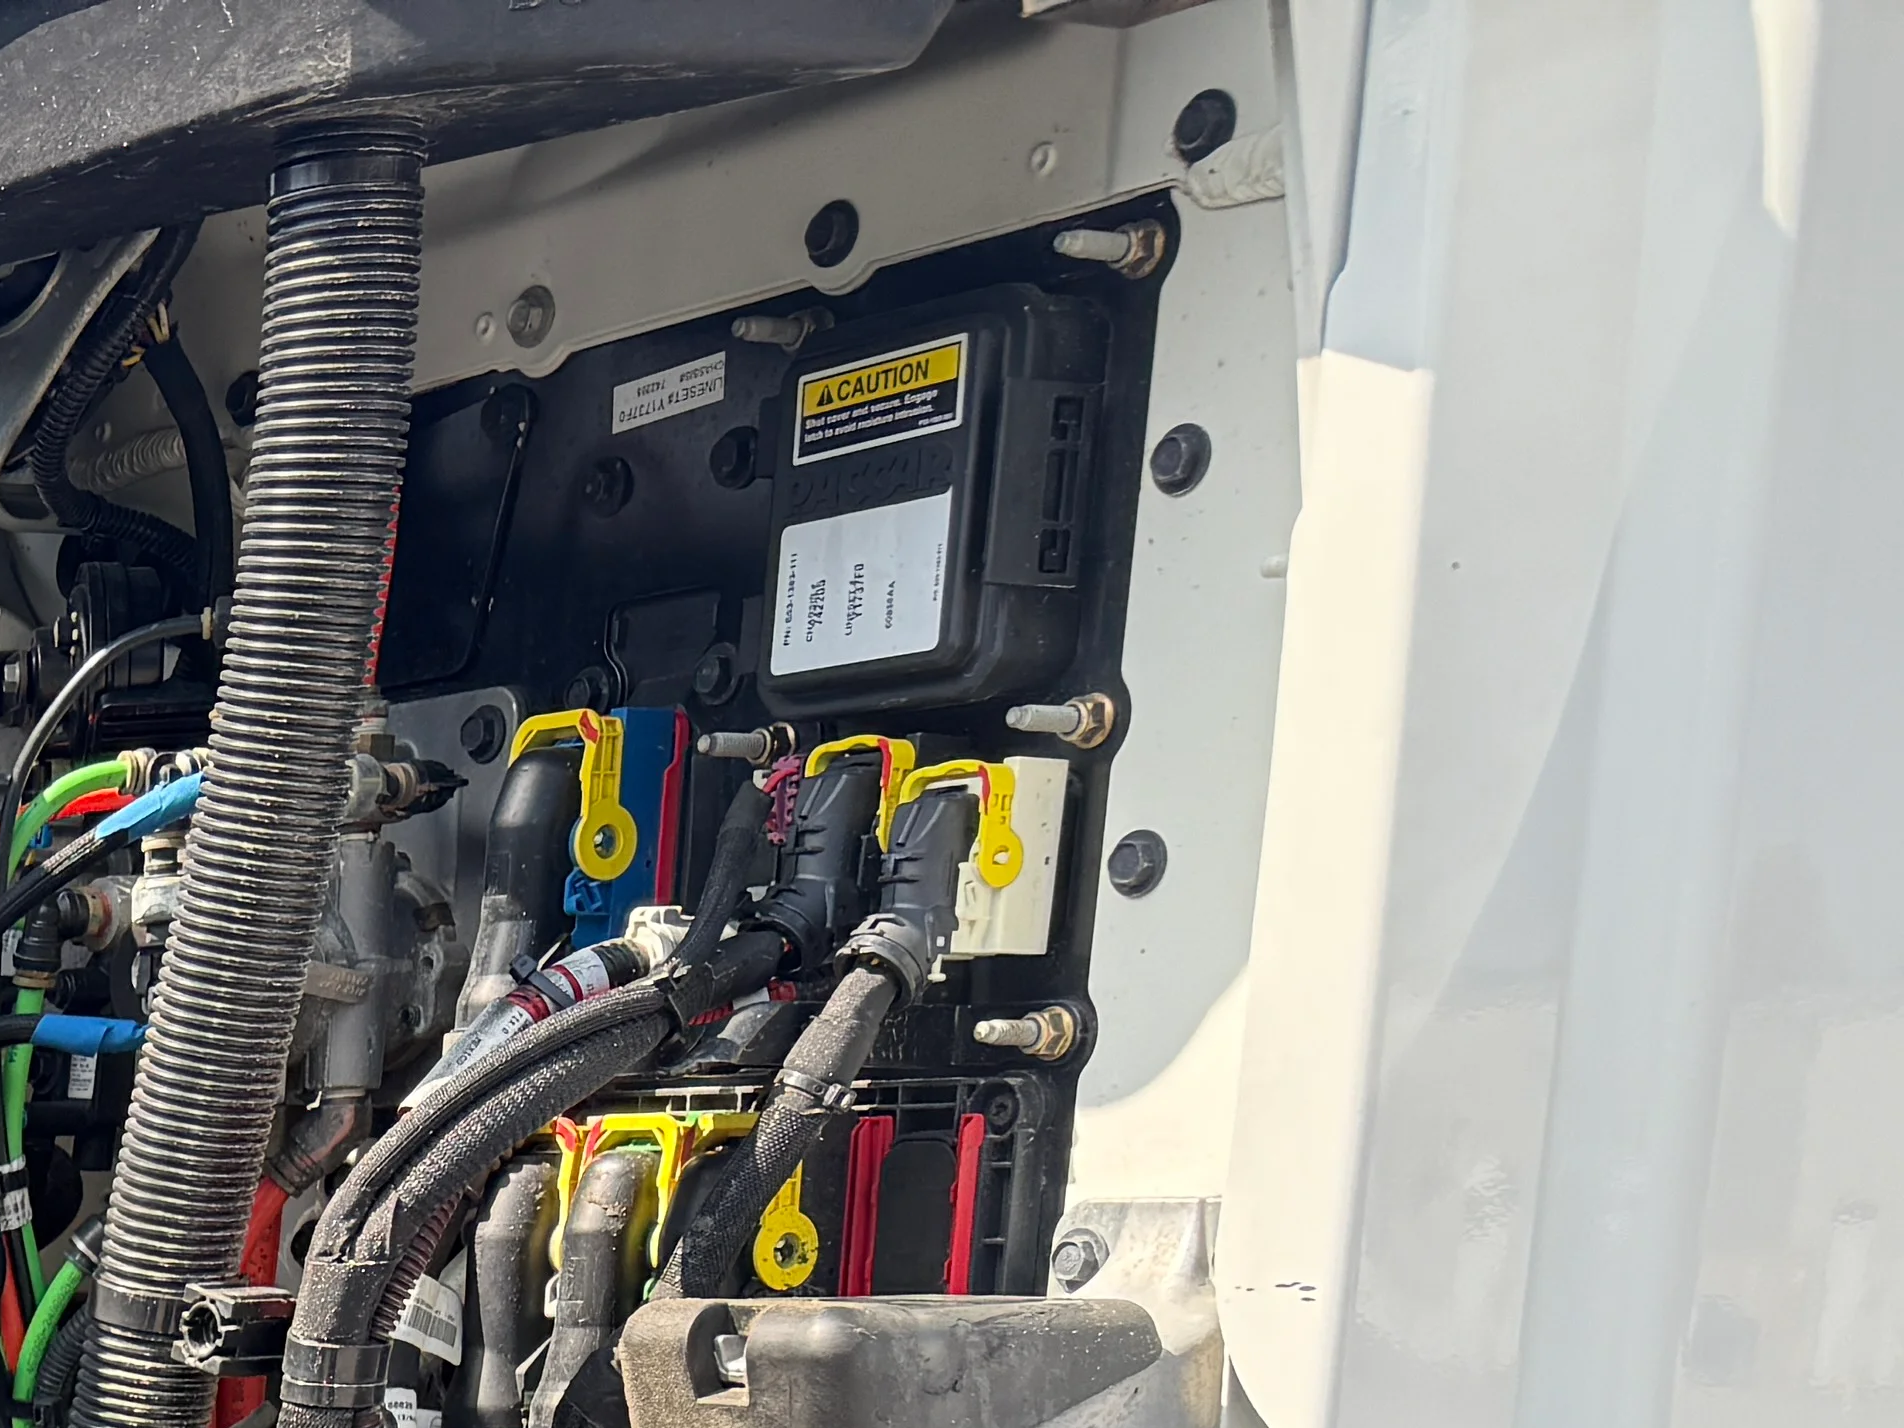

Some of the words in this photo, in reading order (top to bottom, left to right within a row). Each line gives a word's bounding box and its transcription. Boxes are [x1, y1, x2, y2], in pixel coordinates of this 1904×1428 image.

[836, 357, 929, 402] CAUTION
[851, 404, 869, 418] and
[824, 427, 833, 438] to
[834, 421, 856, 436] avoid
